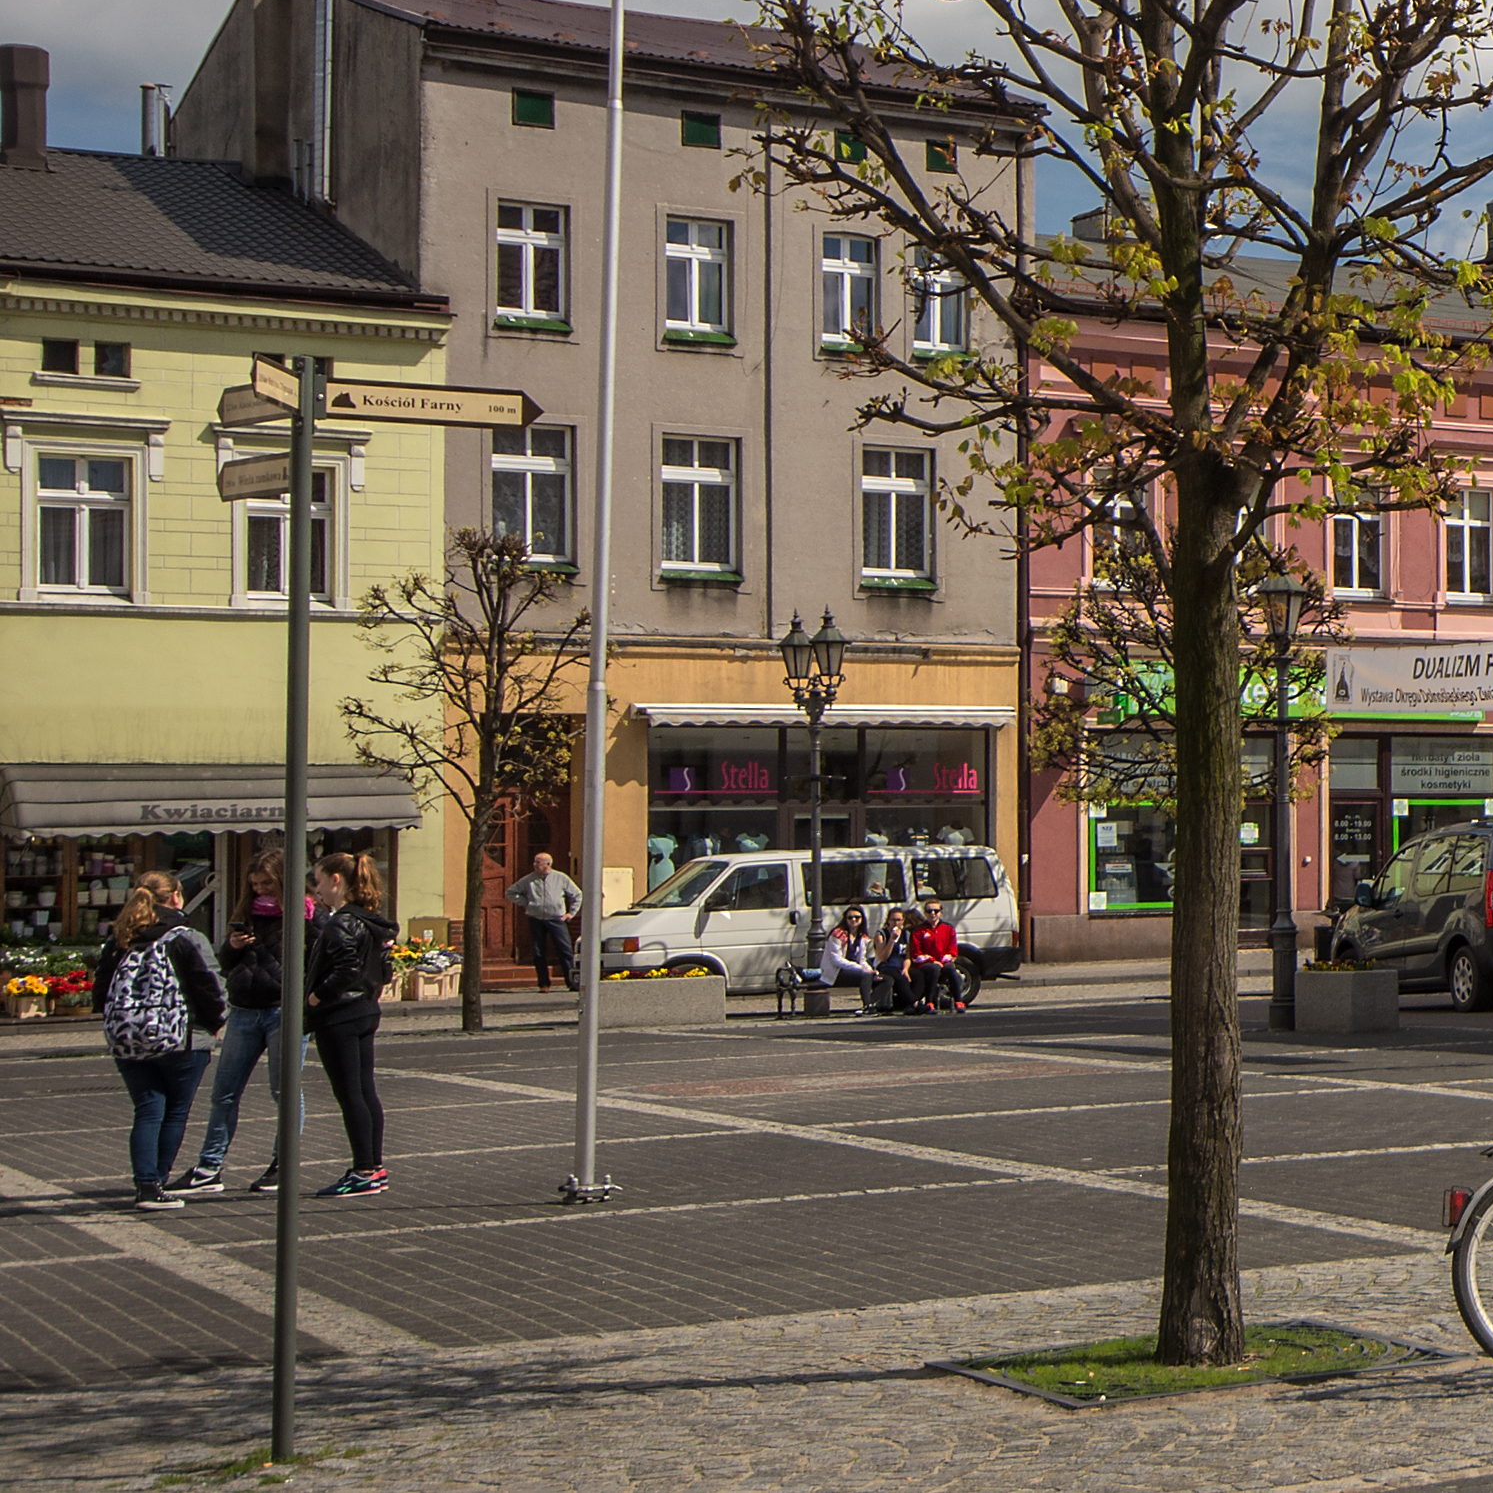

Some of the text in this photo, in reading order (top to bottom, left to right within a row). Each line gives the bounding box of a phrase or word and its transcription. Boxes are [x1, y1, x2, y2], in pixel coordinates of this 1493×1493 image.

[362, 394, 415, 409] Kościół
[420, 398, 464, 413] Farny
[488, 405, 504, 413] 100
[1413, 654, 1481, 680] DUALIZM
[1361, 687, 1394, 706] Wystawa
[1395, 687, 1421, 707] Okręgu
[1419, 687, 1477, 707] Dolnośląskiego
[1411, 753, 1448, 764] herbaty
[1457, 753, 1480, 762] zioła
[721, 761, 769, 789] Stella
[933, 762, 977, 789] Stella
[1400, 766, 1490, 779] środki higieniczne
[1420, 779, 1472, 792] kosmetyki
[140, 804, 309, 821] Kwiaciarn
